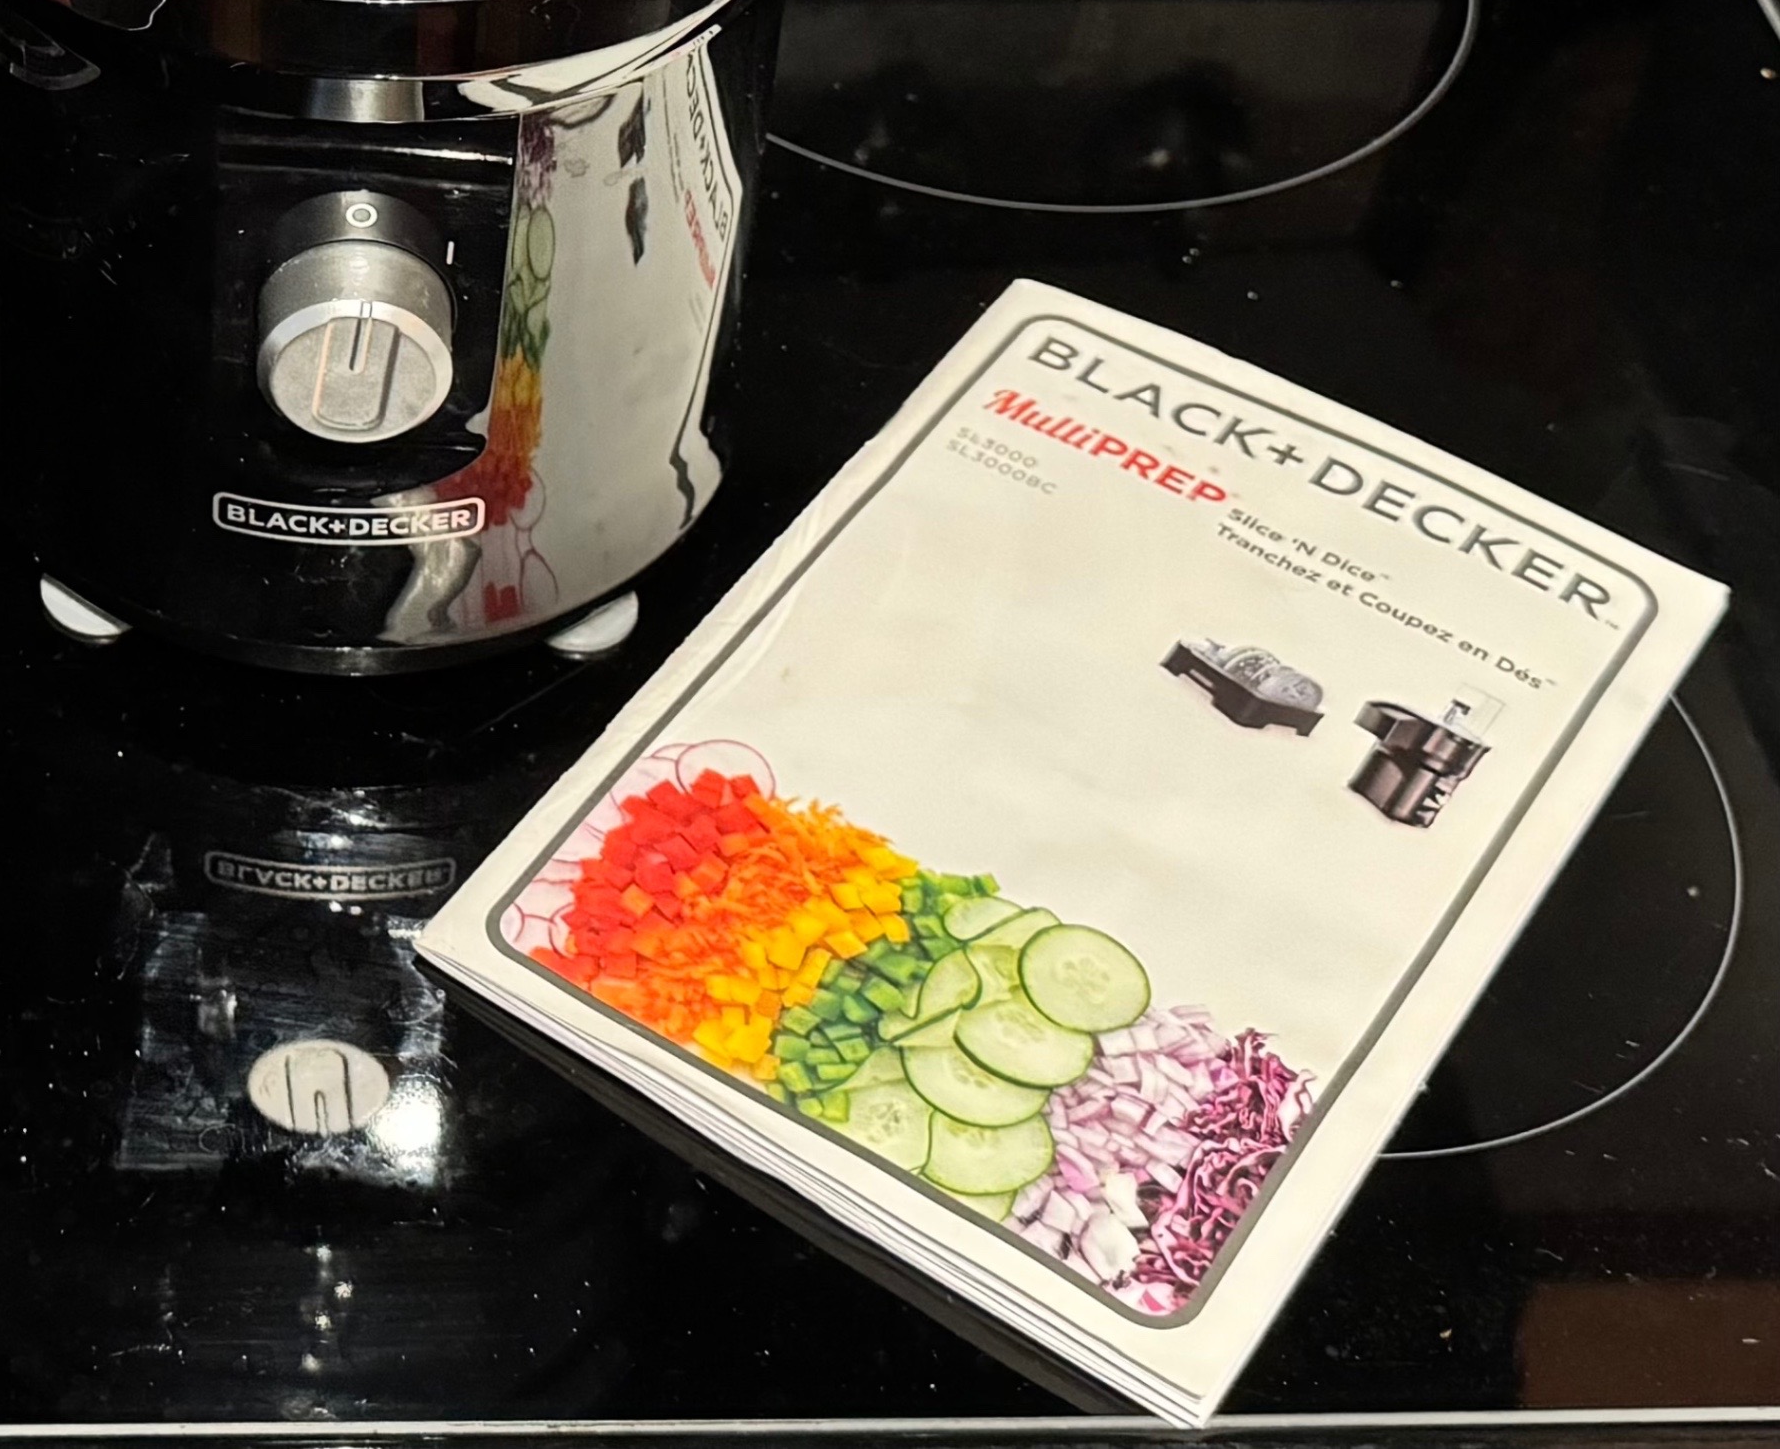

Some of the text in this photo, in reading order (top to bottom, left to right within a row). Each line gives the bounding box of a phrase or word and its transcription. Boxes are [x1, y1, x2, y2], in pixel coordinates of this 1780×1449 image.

[946, 439, 1058, 495] SL3000BC
[956, 426, 1038, 470] SL3000
[983, 389, 1227, 502] MultiPREP
[1027, 336, 1610, 621] BLACK+DECKER
[227, 503, 470, 537] BLACK+DECKER
[1227, 508, 1284, 541] Slice
[1217, 523, 1323, 583] Tranchez
[1326, 579, 1354, 597] et
[1359, 590, 1453, 643] Coupez
[1458, 639, 1489, 662] en
